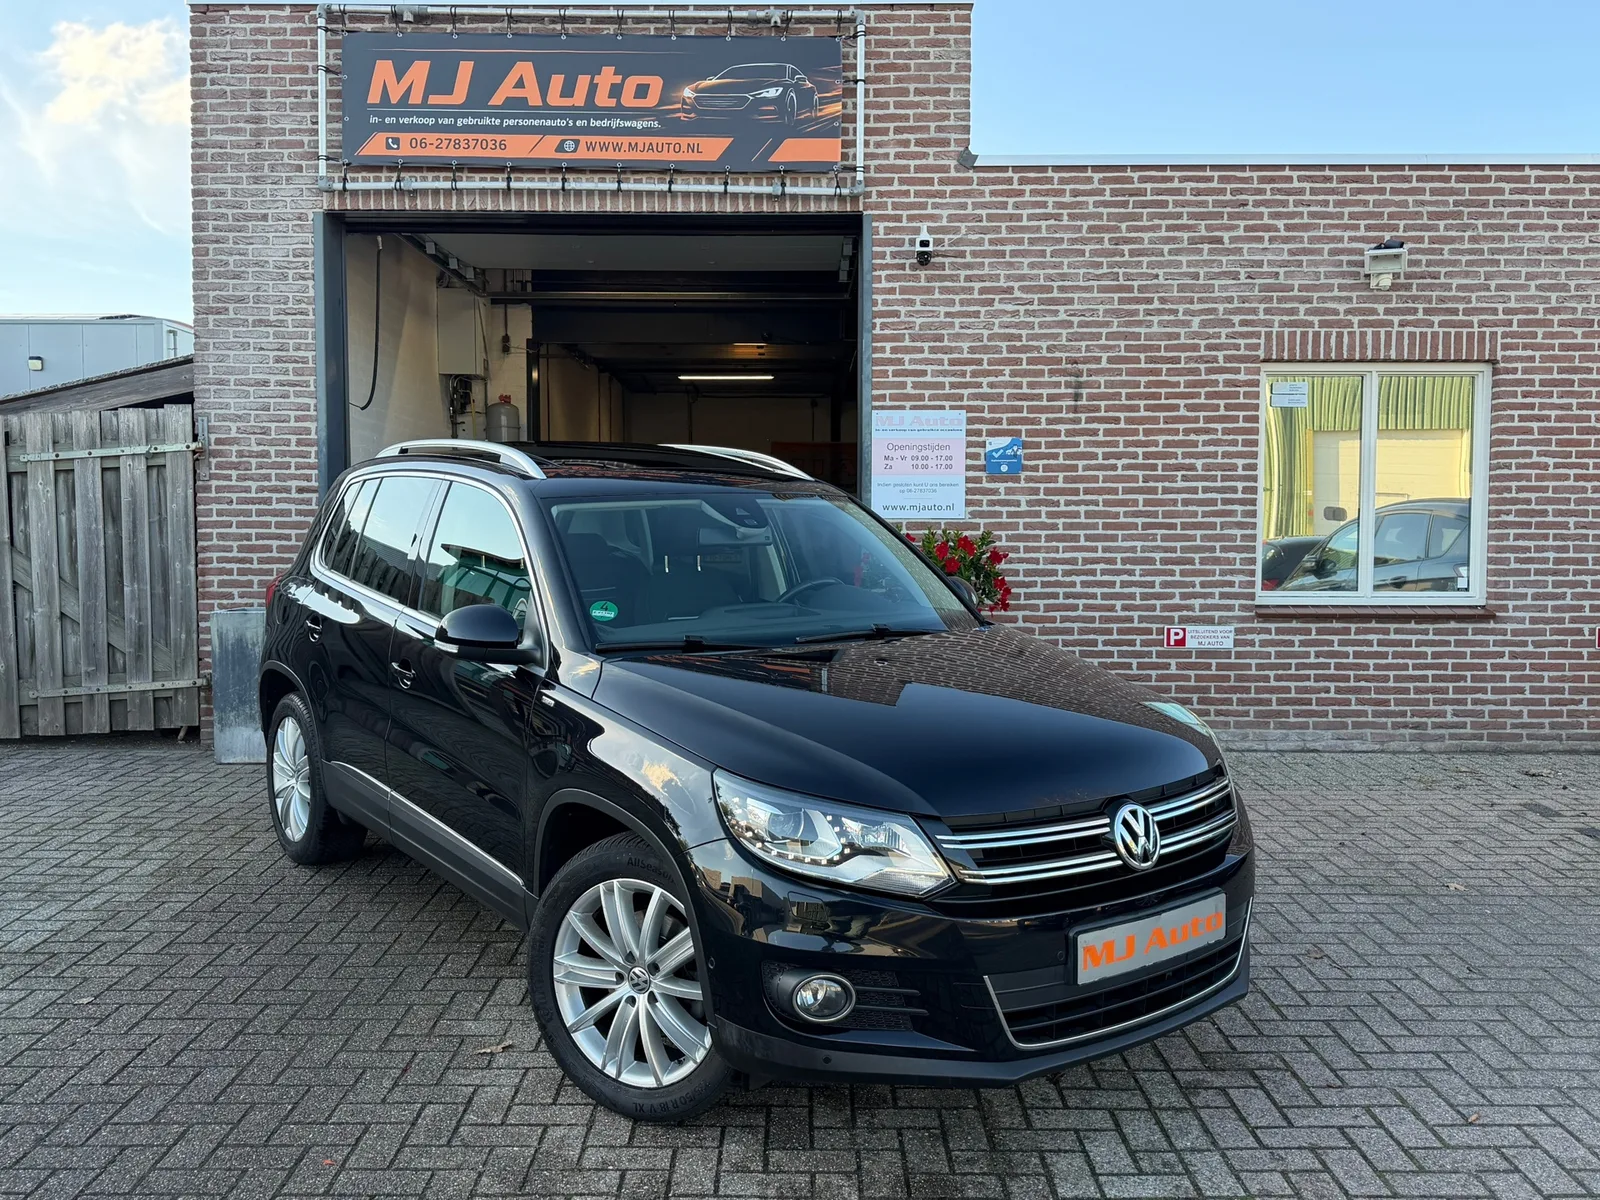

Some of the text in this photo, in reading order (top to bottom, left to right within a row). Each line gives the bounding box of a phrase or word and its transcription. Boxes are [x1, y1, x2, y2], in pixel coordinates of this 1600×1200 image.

[367, 60, 663, 108] MJ Auto
[369, 115, 662, 129] in- en verkoop van gebruikte personenauto's en bedrijfswagens.
[409, 137, 507, 150] 06-27837036
[585, 141, 703, 154] WWW.MJAUTO.NL
[875, 416, 963, 426] MJ Auto
[886, 442, 951, 453] Openingstijden
[882, 503, 955, 512] www.mjauto.nl
[600, 602, 609, 611] 4
[1170, 628, 1184, 645] P
[1082, 911, 1223, 971] MJ Auto
